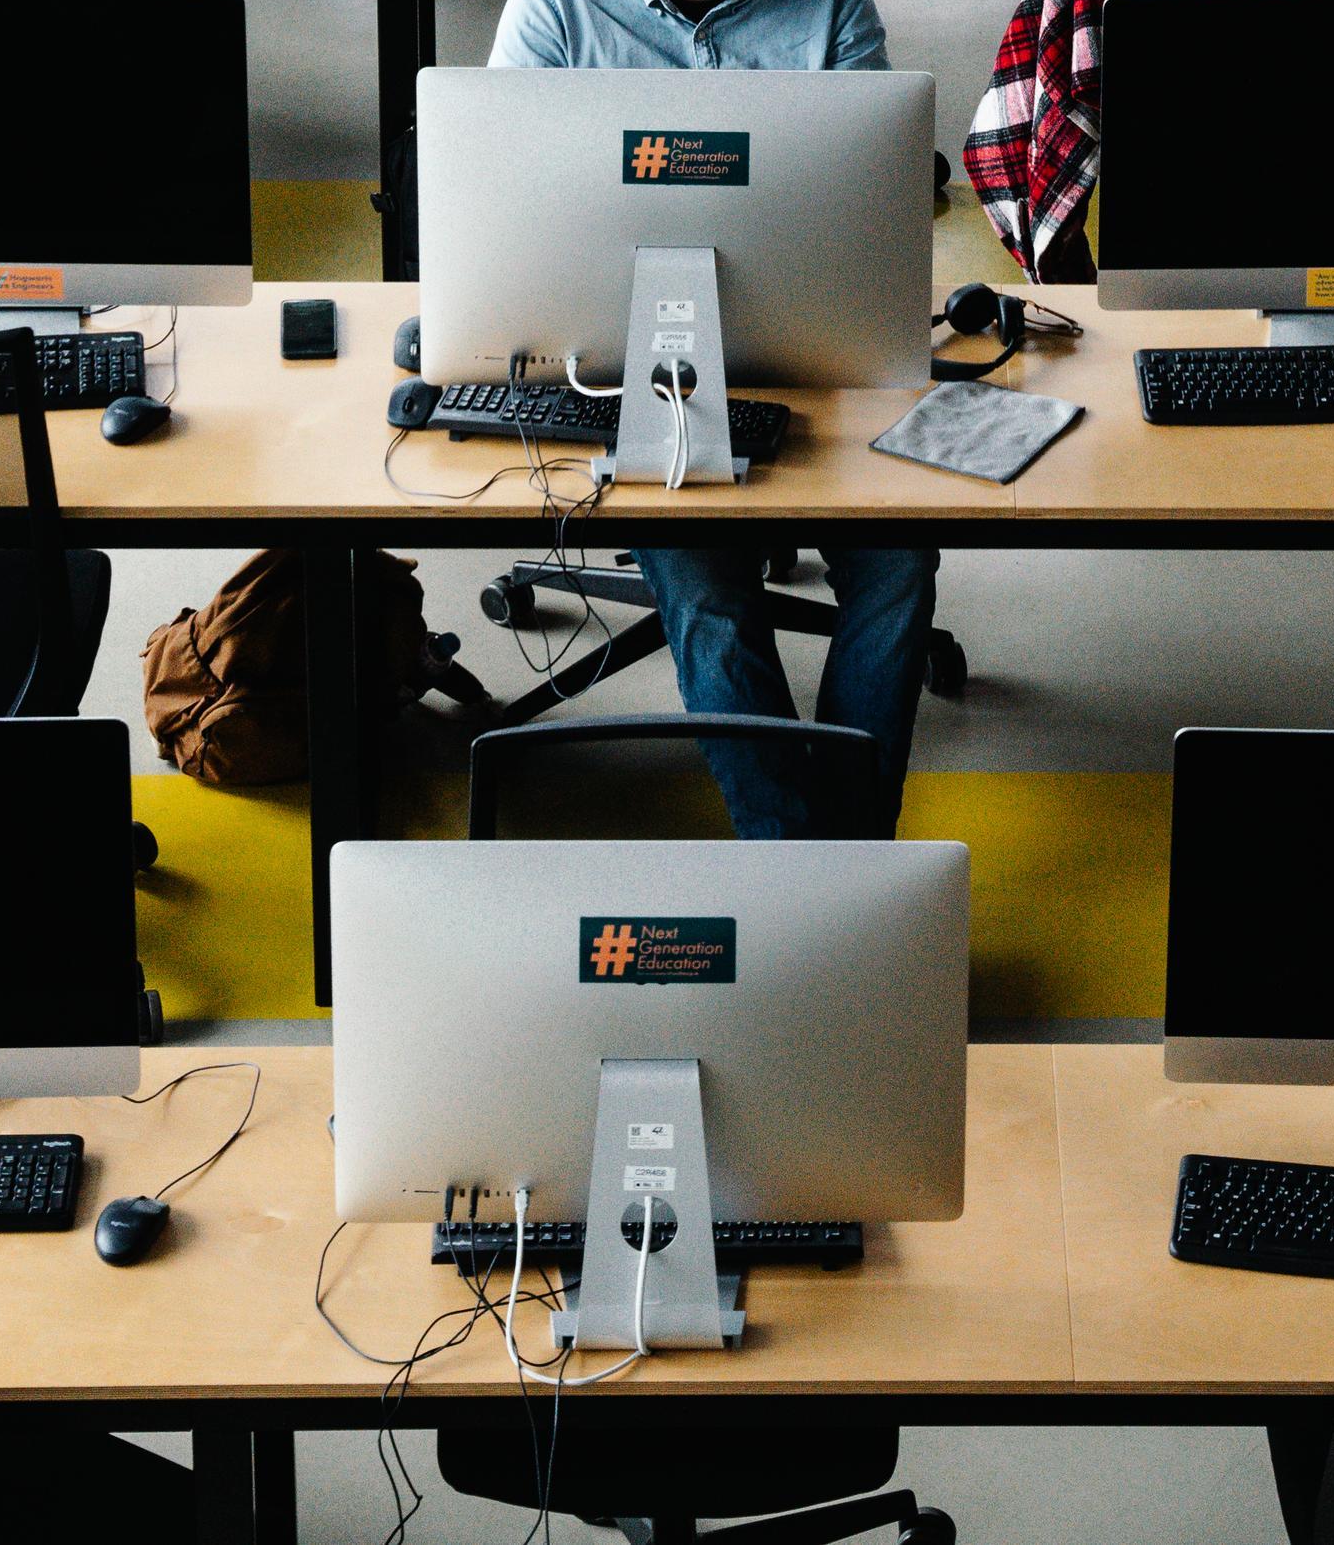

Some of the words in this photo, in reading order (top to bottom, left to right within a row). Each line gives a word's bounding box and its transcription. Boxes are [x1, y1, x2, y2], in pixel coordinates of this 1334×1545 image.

[672, 138, 703, 149] Next
[670, 150, 739, 162] Generation
[669, 162, 729, 174] Education
[641, 925, 679, 939] Next
[639, 940, 724, 955] Generation
[637, 955, 711, 969] Education
